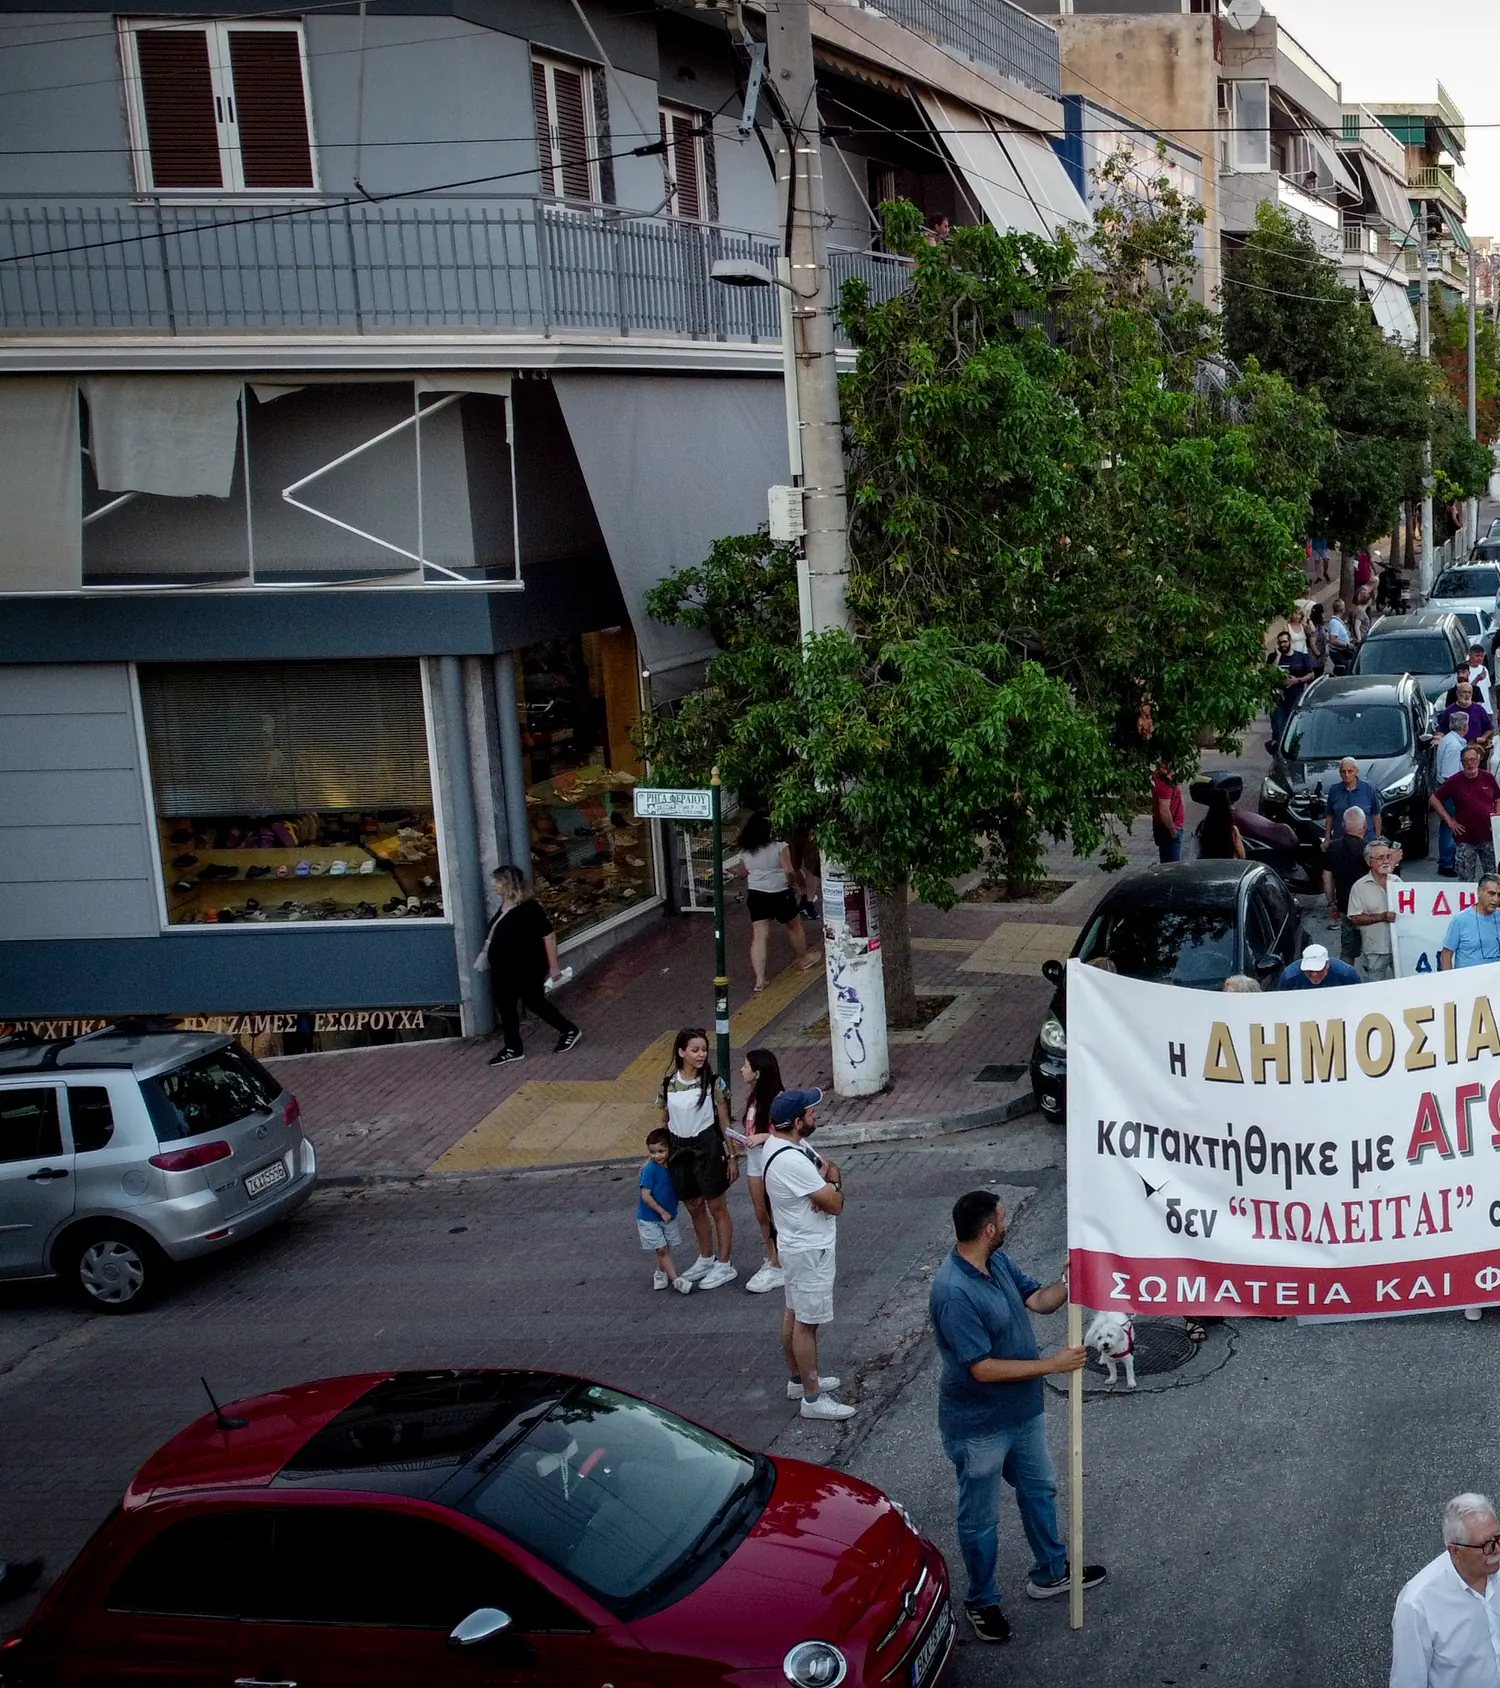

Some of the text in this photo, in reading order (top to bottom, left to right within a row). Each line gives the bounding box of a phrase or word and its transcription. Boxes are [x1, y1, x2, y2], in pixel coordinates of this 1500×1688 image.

[646, 793, 707, 805] ΡΗΓΑ ΦΕΡΑΙΟΥ
[1398, 888, 1415, 915] Η
[184, 1013, 298, 1034] ΠΥΤΖΑΜΕΣ
[313, 1010, 425, 1032] ΕΣΩΡΟΥΧΑ
[1168, 1041, 1188, 1077] Η
[1097, 1119, 1339, 1190] κατακτήθηκε
[1352, 1134, 1395, 1189] με
[1166, 1198, 1218, 1238] δεν
[1109, 1271, 1352, 1305] ΣΩΜΑΤΕΙΑ
[1376, 1272, 1451, 1301] ΚΑΙ
